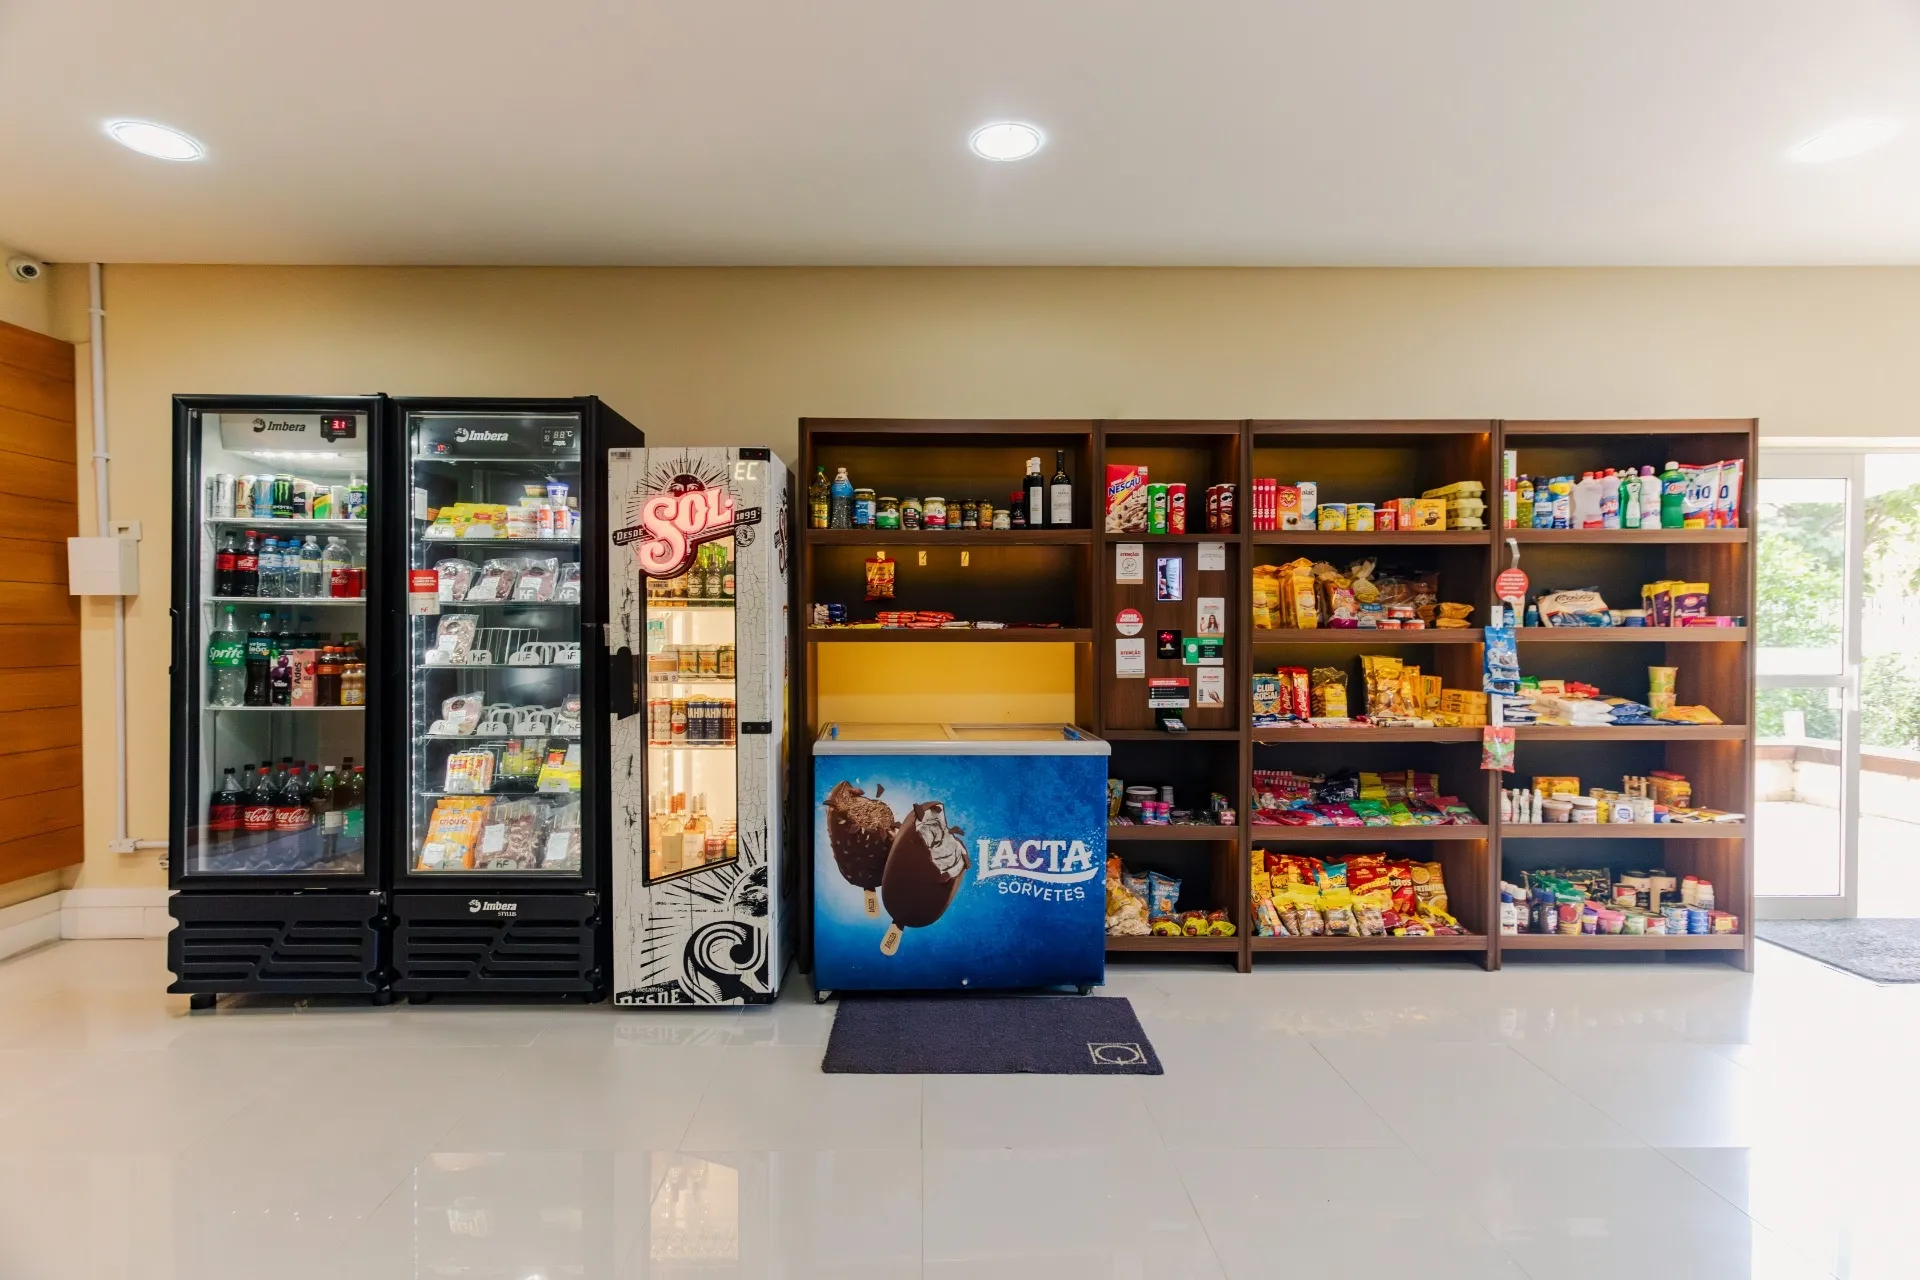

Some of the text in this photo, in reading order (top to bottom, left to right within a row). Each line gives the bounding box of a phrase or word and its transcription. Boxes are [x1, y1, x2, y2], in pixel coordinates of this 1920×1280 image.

[267, 420, 306, 432] Imbera
[469, 430, 509, 441] Imbera
[734, 462, 758, 481] EC
[1107, 475, 1142, 497] NESCAU
[736, 511, 757, 521] 1899
[616, 530, 643, 540] DESDE
[640, 488, 734, 574] SOL
[208, 645, 244, 660] Sprite
[294, 662, 302, 684] AdeS
[1256, 683, 1274, 692] CLUB
[1254, 691, 1278, 701] SOCIAL
[977, 839, 1096, 882] LACTA
[998, 881, 1085, 902] SORVETES
[482, 901, 517, 911] Imbera
[884, 932, 897, 950] LACTA
